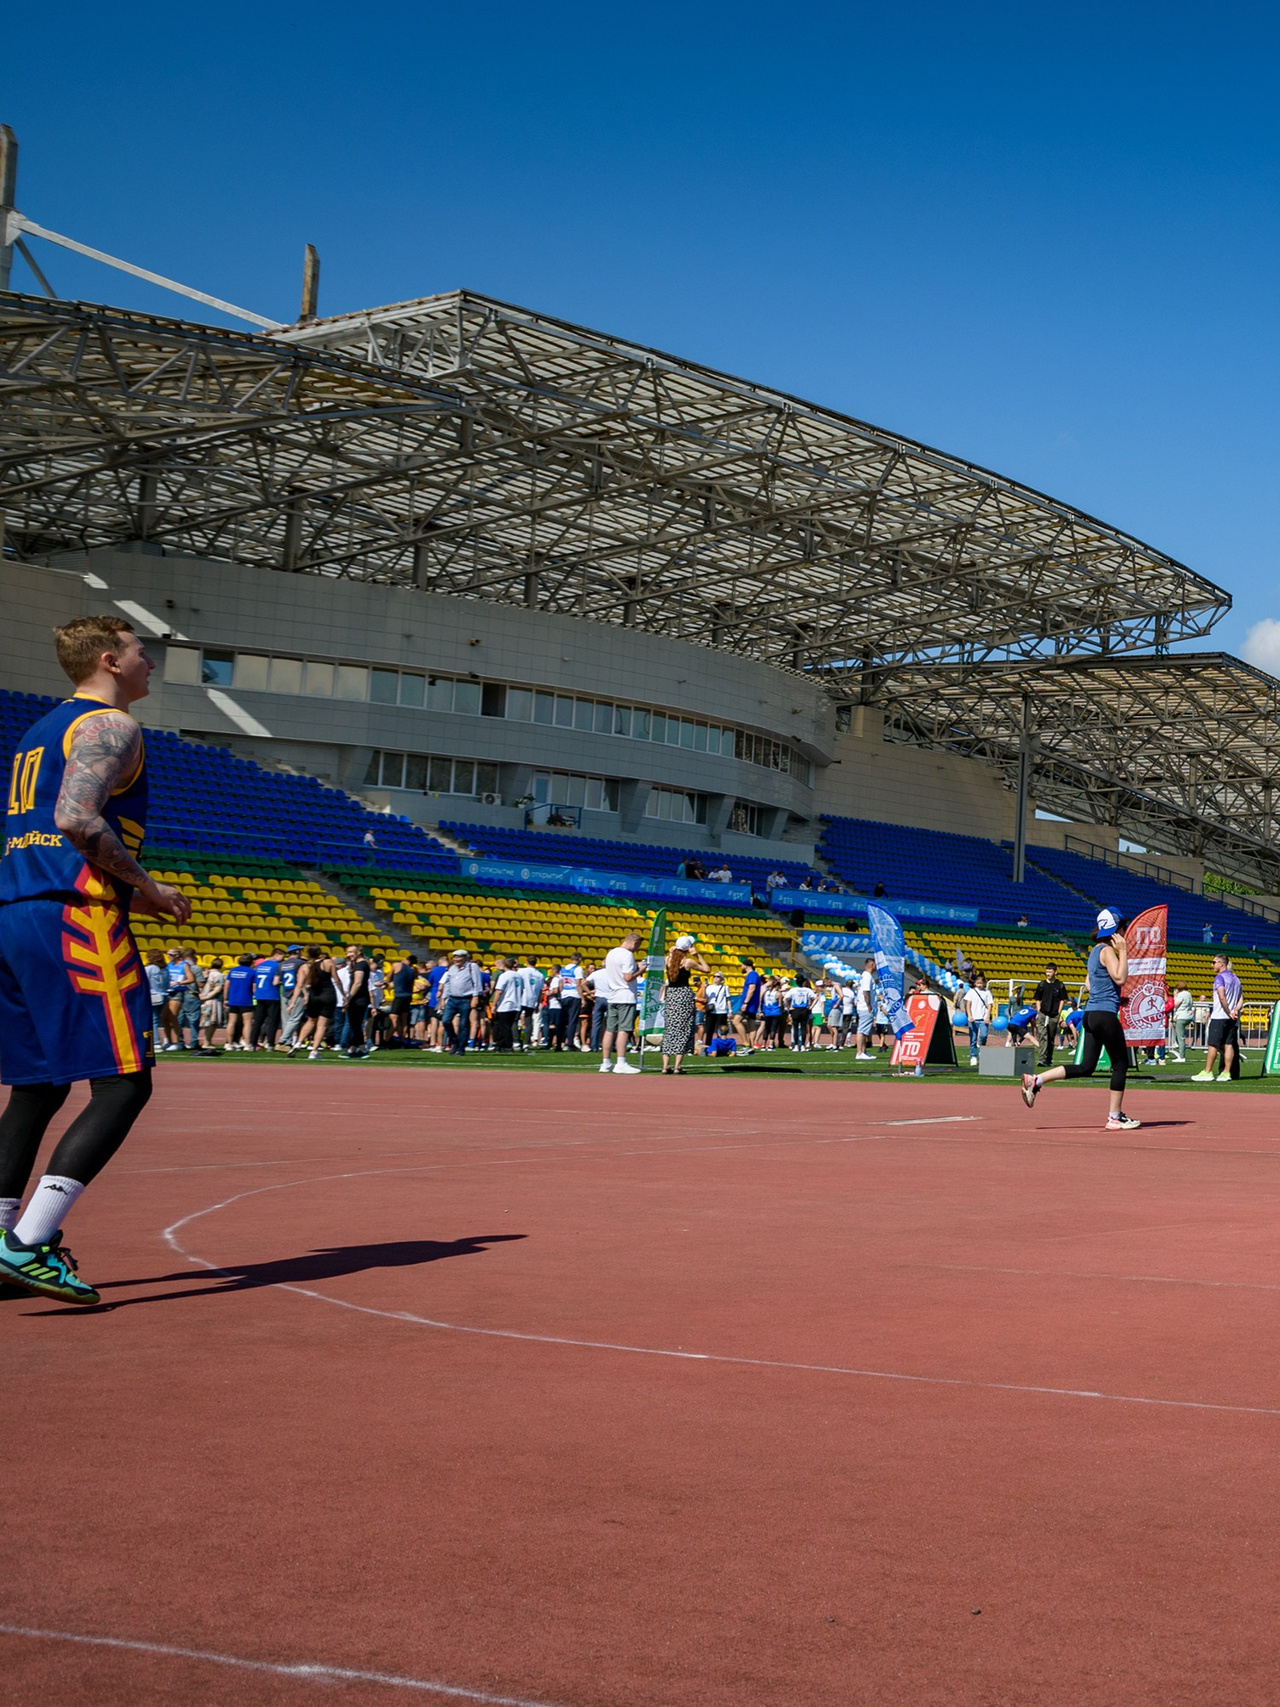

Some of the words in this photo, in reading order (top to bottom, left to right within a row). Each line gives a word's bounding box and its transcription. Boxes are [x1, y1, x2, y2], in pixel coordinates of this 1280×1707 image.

[7, 747, 45, 815] 10
[257, 974, 267, 988] 7
[283, 972, 294, 986] 2
[901, 1041, 921, 1056] ГТО
